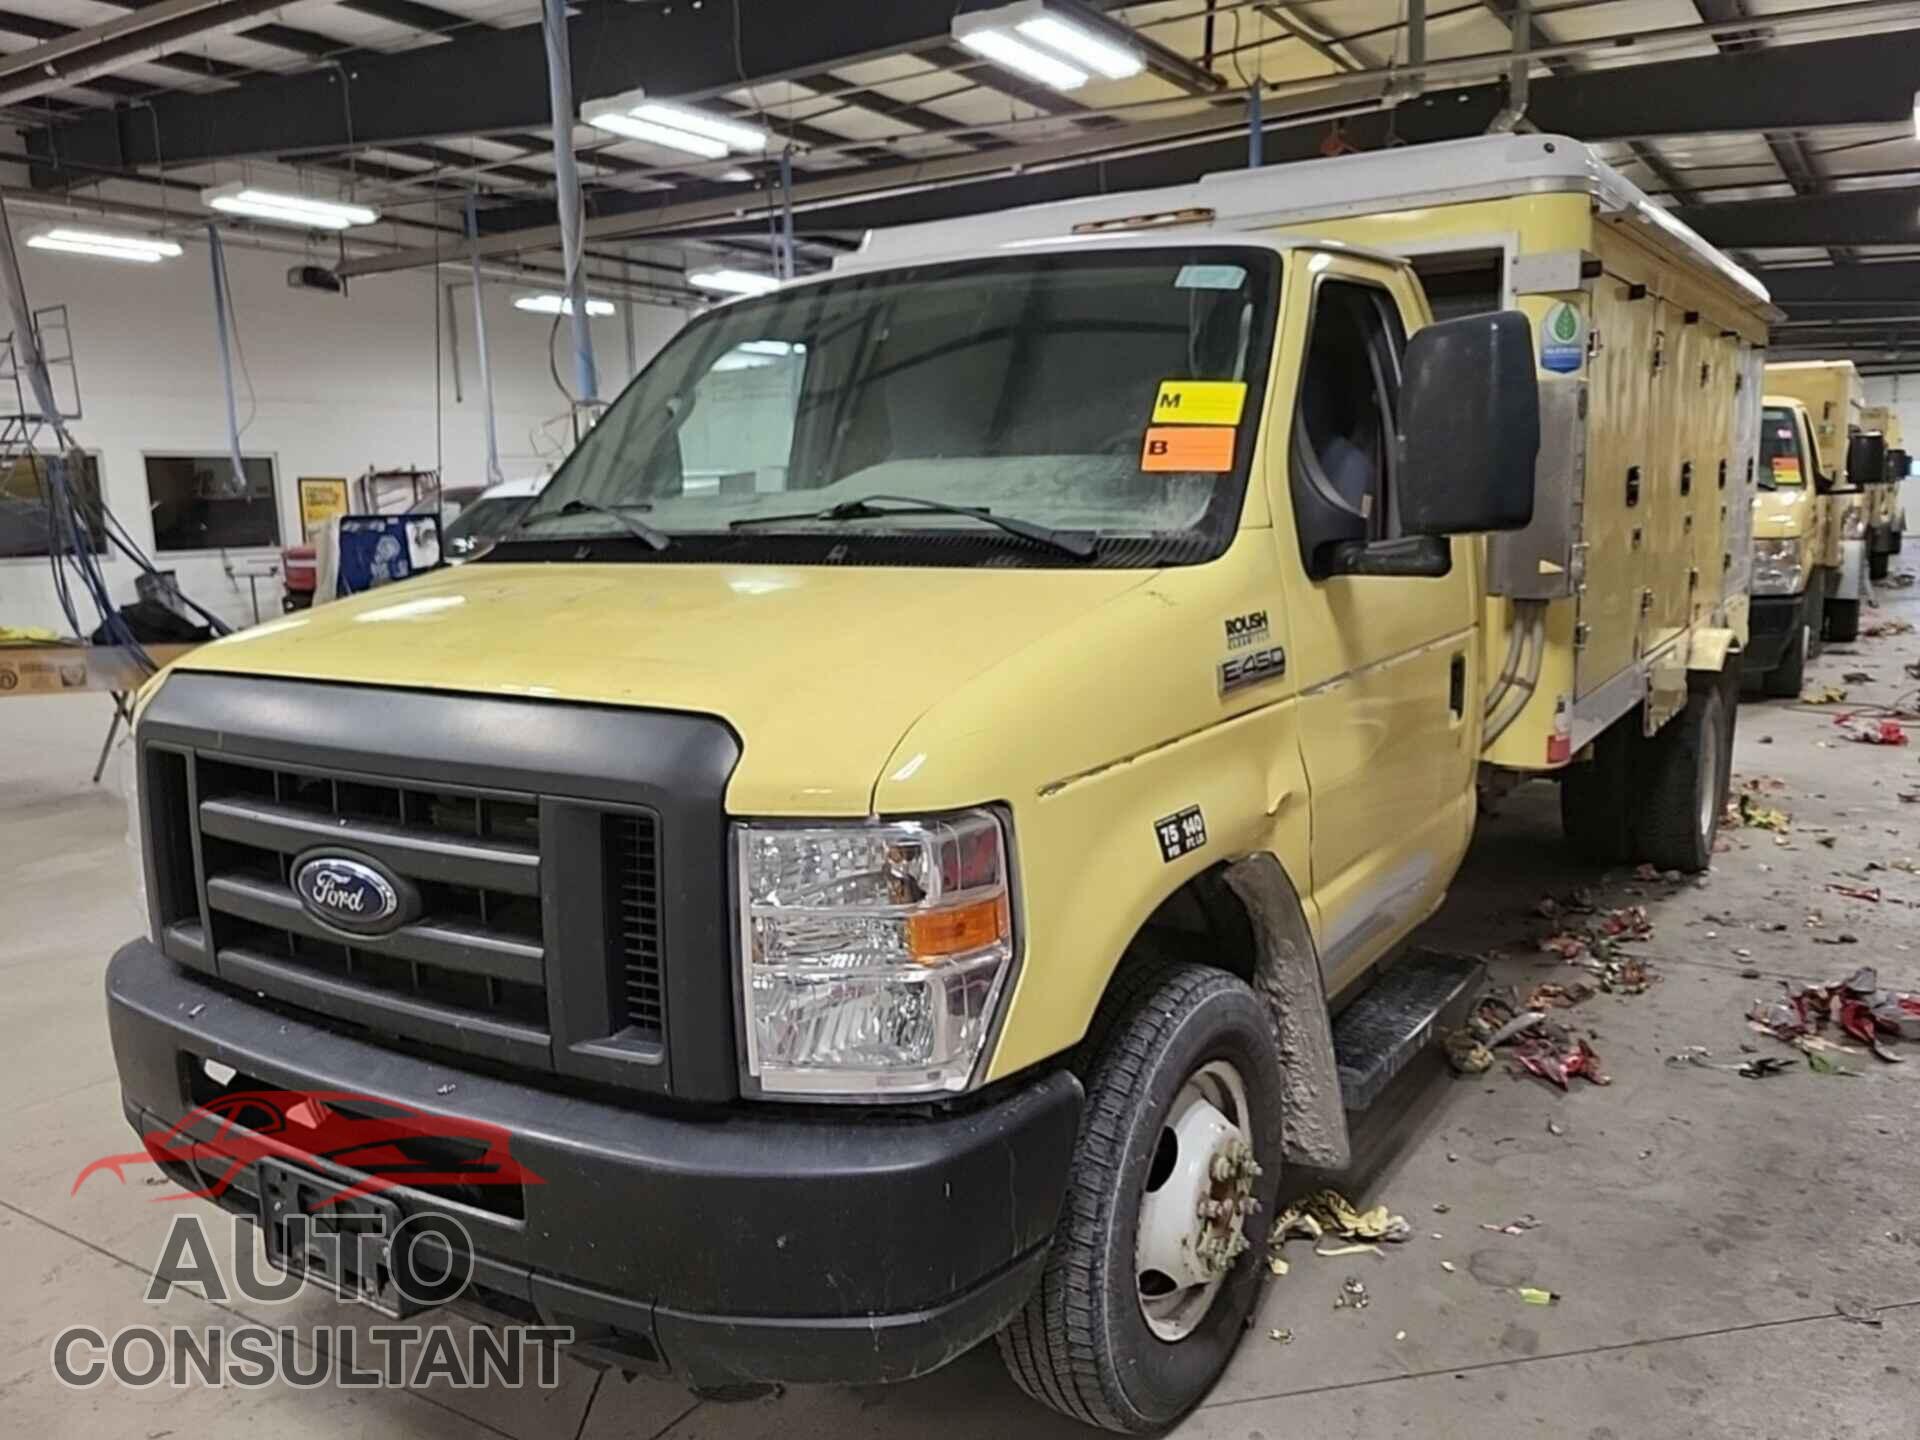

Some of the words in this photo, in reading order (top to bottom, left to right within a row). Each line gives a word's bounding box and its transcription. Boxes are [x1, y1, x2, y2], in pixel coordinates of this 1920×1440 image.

[1160, 393, 1181, 408] M
[1148, 440, 1168, 455] B
[1225, 610, 1268, 636] ROUSH
[1160, 823, 1179, 846] 75
[1182, 813, 1203, 837] 140
[312, 869, 365, 912] Ford
